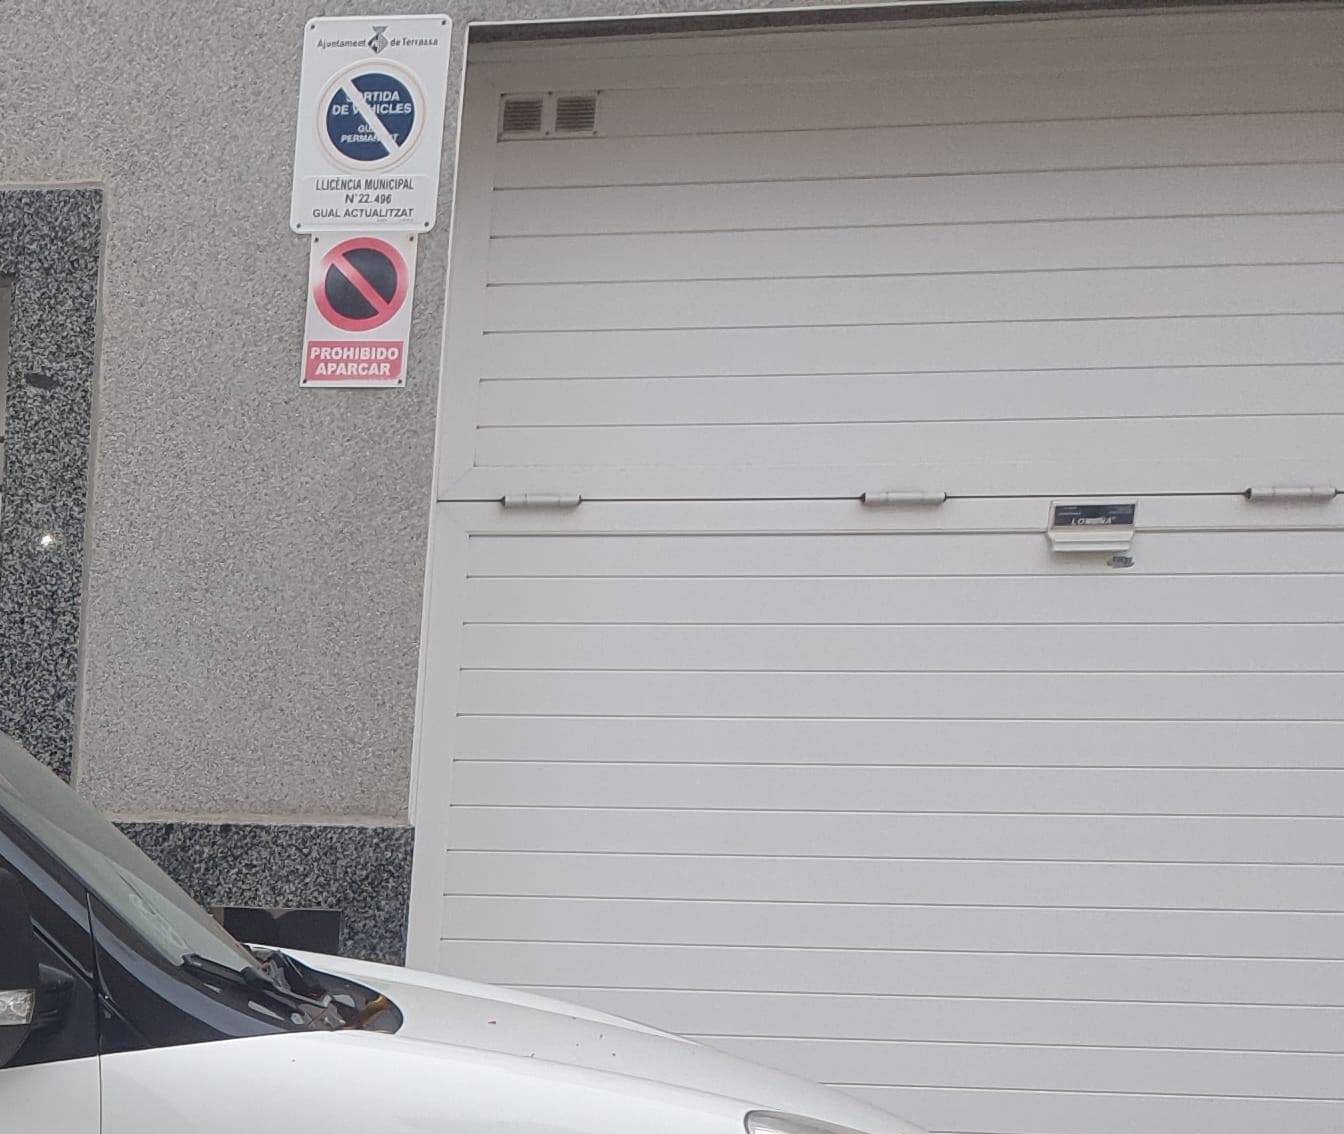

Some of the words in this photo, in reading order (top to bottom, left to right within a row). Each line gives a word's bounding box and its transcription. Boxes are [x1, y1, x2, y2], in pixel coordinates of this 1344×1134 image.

[390, 37, 401, 47] de
[345, 90, 401, 103] RTIDA
[332, 104, 350, 116] DE
[364, 178, 414, 191] MUNICIPAL
[312, 208, 341, 218] GUAL
[343, 207, 415, 218] ACTUALITZAT
[310, 346, 399, 360] PROHIBIDO
[315, 362, 391, 376] APARCAR
